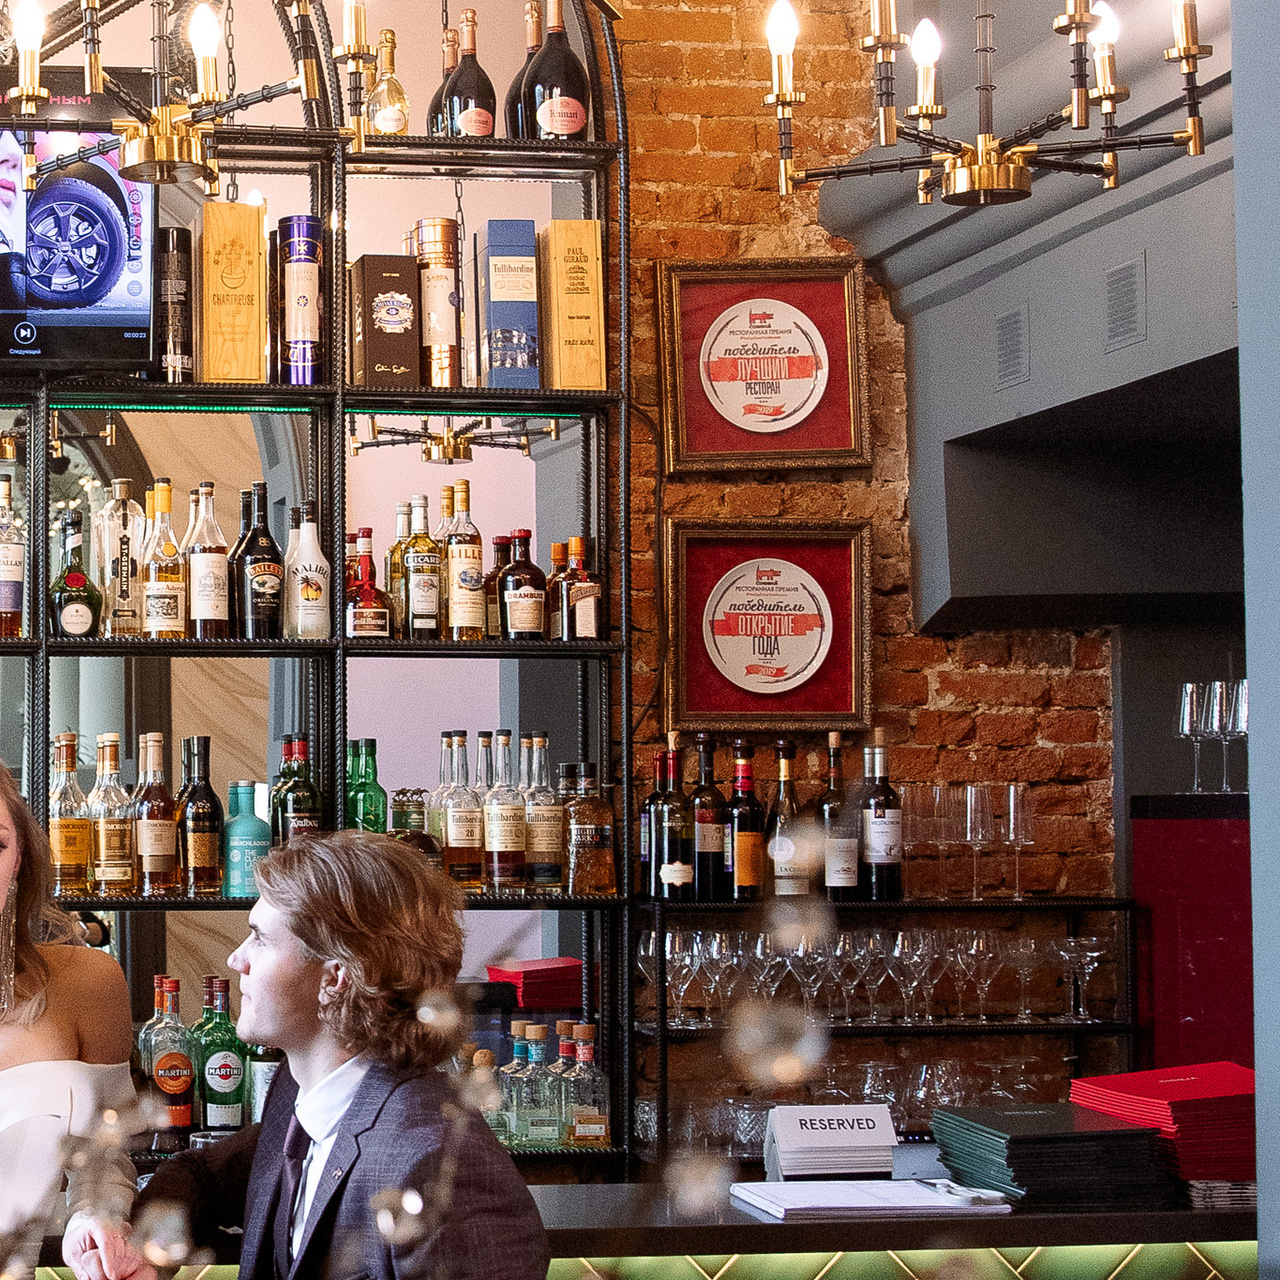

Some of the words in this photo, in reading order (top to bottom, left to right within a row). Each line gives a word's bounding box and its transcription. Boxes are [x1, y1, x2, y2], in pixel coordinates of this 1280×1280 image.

[563, 255, 589, 264] GIRAUD
[492, 263, 535, 274] Tullibardine
[212, 294, 255, 306] CHARTREUSE
[728, 328, 768, 336] РЕСТОРАННАЯ
[723, 343, 800, 357] победитель
[745, 381, 781, 396] РЕСТОРАН
[408, 555, 440, 564] RICARD
[248, 562, 283, 576] BAILEYS
[291, 563, 329, 579] MALIBU
[507, 592, 544, 601] DRAMBUIE
[728, 598, 805, 612] победитель
[738, 615, 795, 635] ОТКРЫТИЕ
[752, 636, 781, 658] ГОДА
[157, 1068, 191, 1077] MARTINI
[207, 1067, 241, 1076] MARTINI
[798, 1118, 877, 1131] RESERVED
